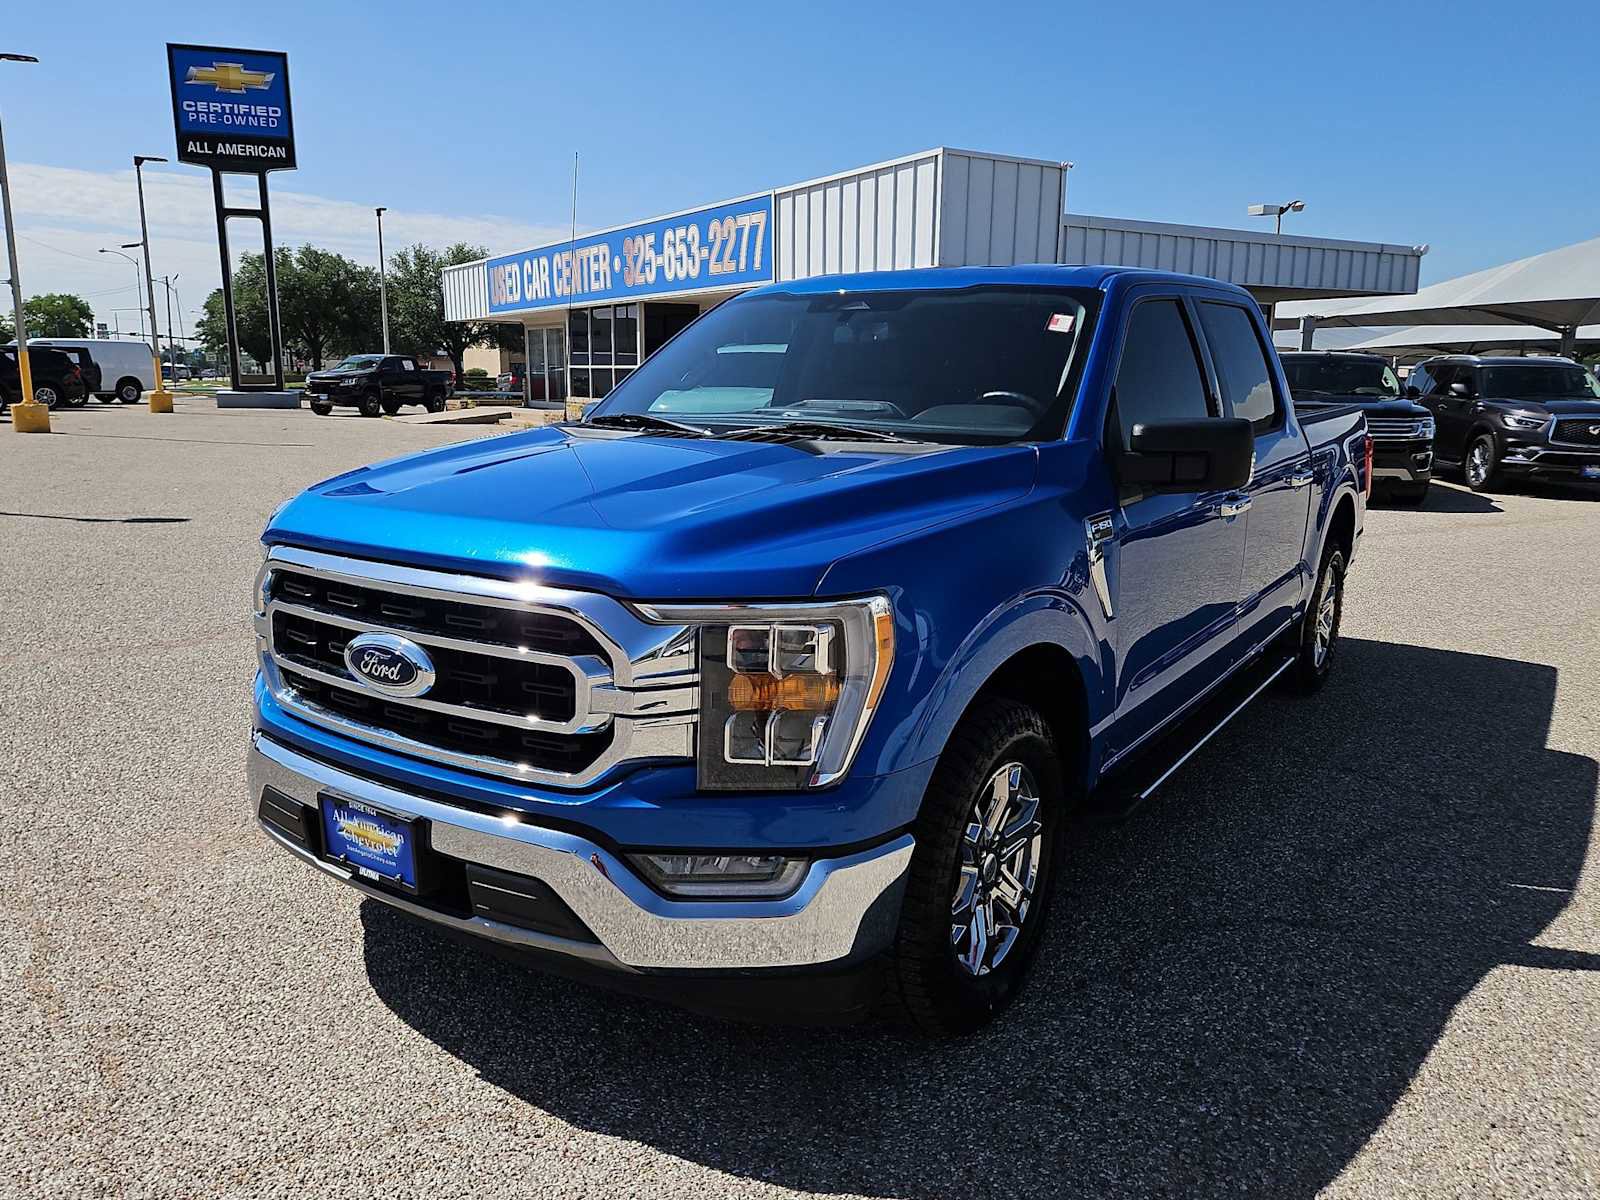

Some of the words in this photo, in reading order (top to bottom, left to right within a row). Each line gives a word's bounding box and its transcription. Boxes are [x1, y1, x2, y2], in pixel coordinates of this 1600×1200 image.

[182, 100, 281, 117] CERTIFIED
[188, 112, 278, 128] PRE-OWNED
[187, 140, 213, 154] ALL
[216, 142, 286, 158] AMERICAN
[490, 262, 521, 306] USED
[523, 256, 551, 301] CAR
[552, 243, 612, 298] CENTER
[623, 210, 768, 288] 325-653-2277
[360, 649, 402, 681] Ford
[333, 809, 348, 823] All
[352, 815, 405, 844] American
[343, 829, 399, 857] Chevrolet
